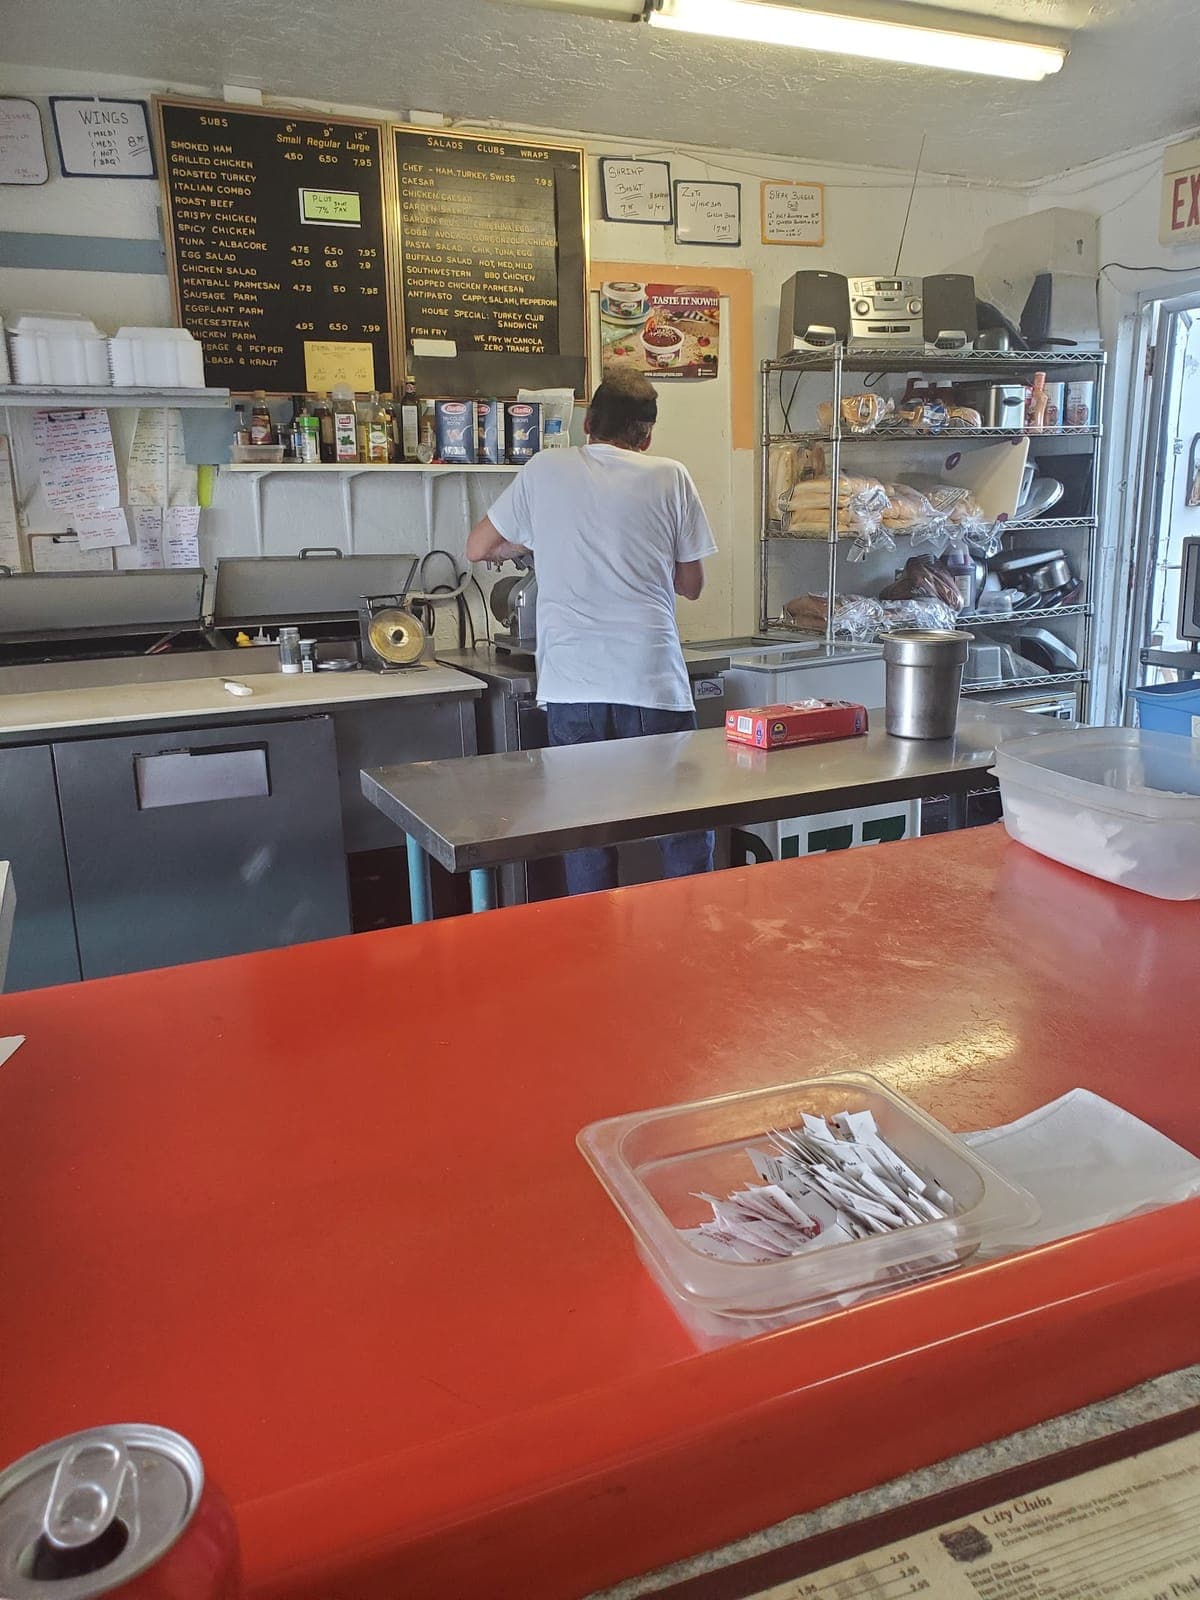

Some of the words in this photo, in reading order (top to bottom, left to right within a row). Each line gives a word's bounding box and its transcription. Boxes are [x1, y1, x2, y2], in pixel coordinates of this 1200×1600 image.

[78, 110, 129, 125] WINGS
[200, 116, 228, 127] SUBS
[171, 141, 209, 152] SMOKED
[213, 145, 233, 154] HAM
[276, 134, 302, 145] Small
[306, 137, 341, 149] Regular
[346, 141, 370, 153] Large
[427, 137, 464, 150] SALADS
[476, 143, 505, 156] CLUBS
[520, 149, 549, 160] WRAPS
[171, 154, 211, 165] GRILLED
[213, 159, 253, 169] CHICKEN
[172, 168, 217, 179] ROASTED
[221, 172, 257, 183] TURKEY
[402, 162, 424, 173] CHEF
[489, 172, 516, 183] SWISS
[608, 166, 644, 179] SHRIMP
[401, 177, 435, 187] CAESAR
[174, 182, 213, 192] ITALIAN
[217, 186, 251, 196] COMBO
[175, 196, 207, 206] ROAST
[210, 199, 235, 208] BEEF
[402, 190, 440, 200] CHICKEN
[440, 192, 472, 203] CAESAR
[403, 202, 437, 213] GARDEN
[177, 211, 212, 220] CRISPY
[215, 214, 257, 223] CHICKEN
[403, 214, 438, 225] GARDEN
[178, 224, 206, 233] SPICY
[212, 226, 256, 236] CHICKEN
[178, 237, 205, 245] TUNA
[219, 241, 268, 250] ALBACORE
[405, 241, 431, 249] PASTA
[435, 243, 463, 252] SALAD
[516, 249, 533, 257] EGG
[181, 251, 201, 259] EGG
[205, 252, 236, 261] SALAD
[405, 253, 442, 263] BUFFALO
[446, 256, 473, 265] SALAD
[182, 264, 223, 274] CHICKEN
[226, 267, 257, 276] SALAD
[406, 266, 472, 277] SOUTHWESTERN
[484, 271, 500, 281] BBQ
[502, 271, 535, 282] CHICKEN
[183, 278, 231, 287] MEATBALL
[234, 280, 280, 290] PARMESAN
[407, 278, 445, 288] CHOPPED
[447, 281, 481, 291] CHICKEN
[482, 283, 524, 294] PARMESAN
[183, 289, 226, 300] SAUSAGE
[233, 292, 258, 302] PARM
[407, 291, 453, 301] ANTIPASTO
[652, 296, 680, 305] TASTE
[680, 297, 689, 305] IT
[185, 304, 235, 314] EGGPLANT
[239, 307, 264, 315] PARM
[422, 307, 449, 316] HOUSE
[454, 309, 490, 320] SPECIAL:
[493, 311, 523, 320] TURKEY
[525, 313, 545, 322] CLUB
[186, 318, 250, 328] CHEESESTEAK
[497, 320, 538, 330] SANDWICH
[192, 331, 226, 339] HICKEN
[232, 332, 257, 341] PARM
[410, 327, 429, 336] FISH
[432, 327, 448, 337] FRY
[474, 335, 486, 343] WE
[488, 335, 503, 344] FRY
[513, 337, 543, 345] CANOLA
[249, 345, 284, 354] PEPPER
[483, 344, 504, 352] ZERO
[506, 345, 530, 354] TRANS
[532, 345, 545, 354] FAT
[249, 358, 278, 367] KRAUT
[982, 1507, 1014, 1526] City
[1013, 1495, 1053, 1515] Clubs
